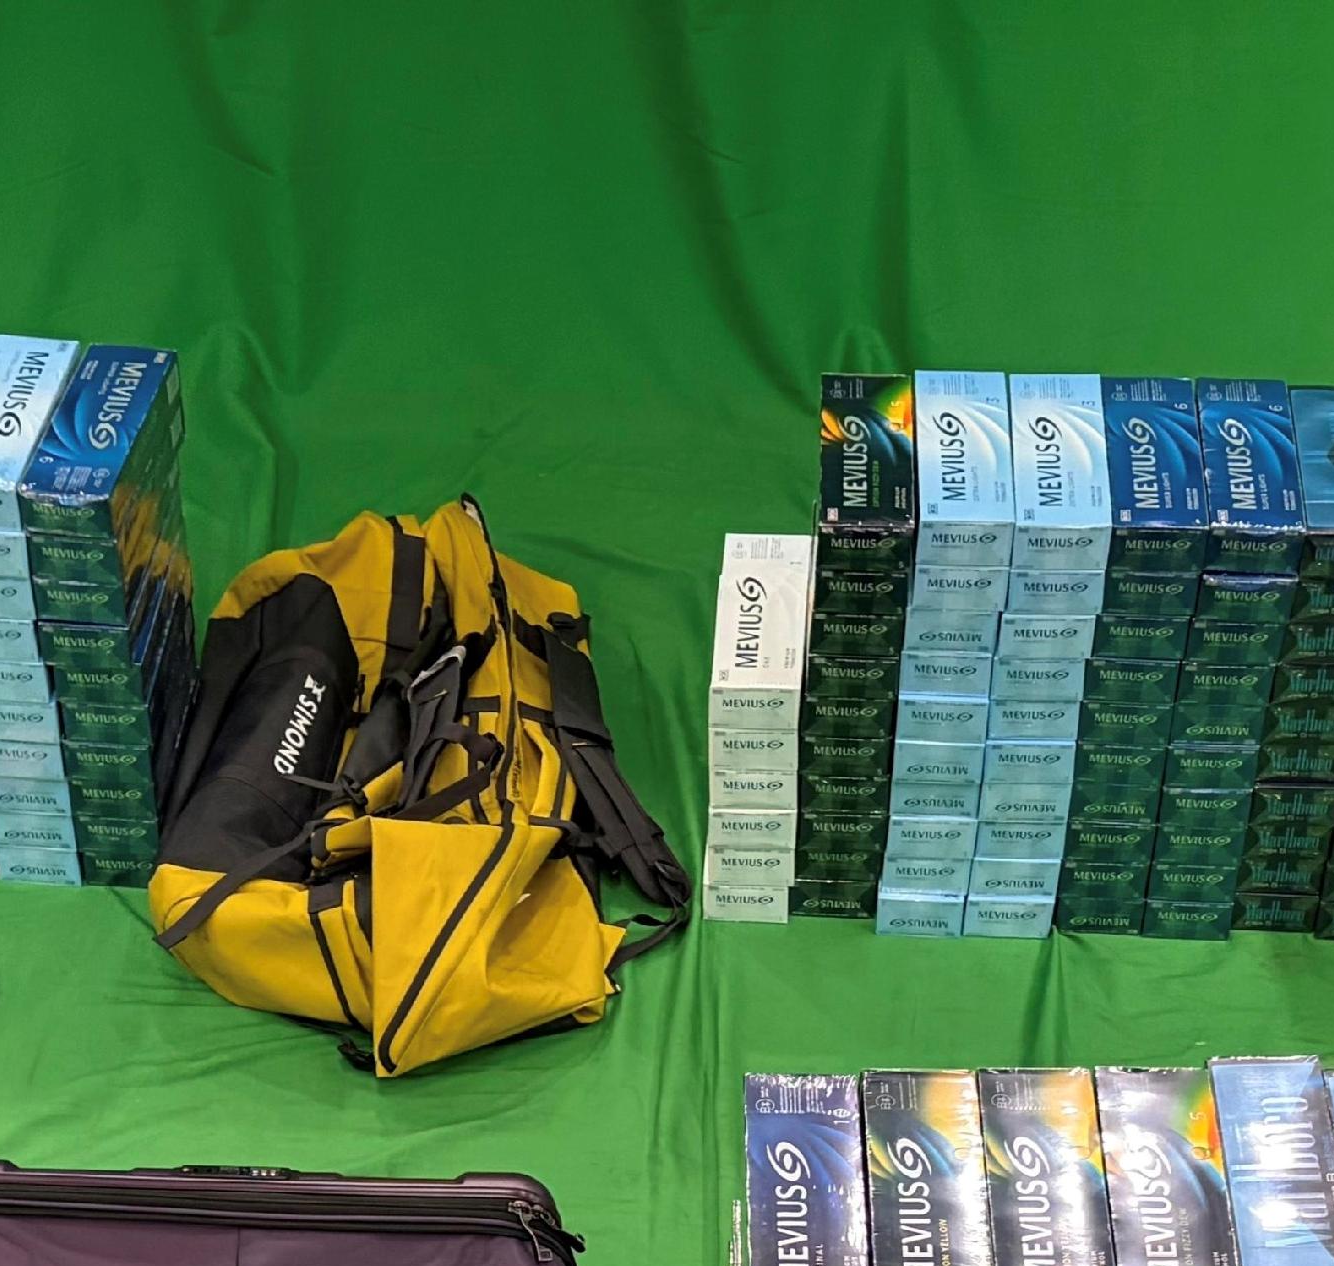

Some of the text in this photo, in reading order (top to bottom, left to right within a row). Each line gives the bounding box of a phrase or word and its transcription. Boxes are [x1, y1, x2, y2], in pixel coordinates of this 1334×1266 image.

[3, 351, 49, 409] MEVIUS
[98, 362, 147, 422] MEVIUS
[843, 441, 867, 507] MEVIUS
[940, 438, 967, 501] MEVIUS
[1035, 443, 1063, 507] MEVIUS
[1130, 445, 1160, 509] MEVIUS
[1226, 446, 1257, 510] MEVIUS
[831, 537, 877, 548] MEVIUS
[931, 533, 978, 544] MEVIUS
[1027, 537, 1073, 548] MEVIUS
[1125, 539, 1171, 550] MEVIUS
[1221, 541, 1266, 552] MEVIUS
[42, 547, 86, 561] MEVIUS
[1118, 583, 1164, 594] MEVIUS
[735, 604, 762, 668] MEVIUS
[53, 636, 98, 648] MEVIUS
[821, 668, 866, 678] MEVIUS
[914, 665, 959, 675] MEVIUS
[1006, 670, 1052, 679] MEVIUS
[1100, 670, 1144, 681] MEVIUS
[1194, 674, 1239, 685] MEVIUS
[722, 699, 766, 708] MEVIUS
[911, 712, 956, 722] MEVIUS
[274, 694, 317, 775] SIMOND
[1205, 725, 1248, 735] MEVIUS
[723, 740, 766, 749] MEVIUS
[998, 754, 1043, 763] MEVIUS
[925, 764, 968, 774] MEVIUS
[721, 822, 764, 831] MEVIUS
[813, 822, 857, 832] MEVIUS
[901, 830, 944, 839] MEVIUS
